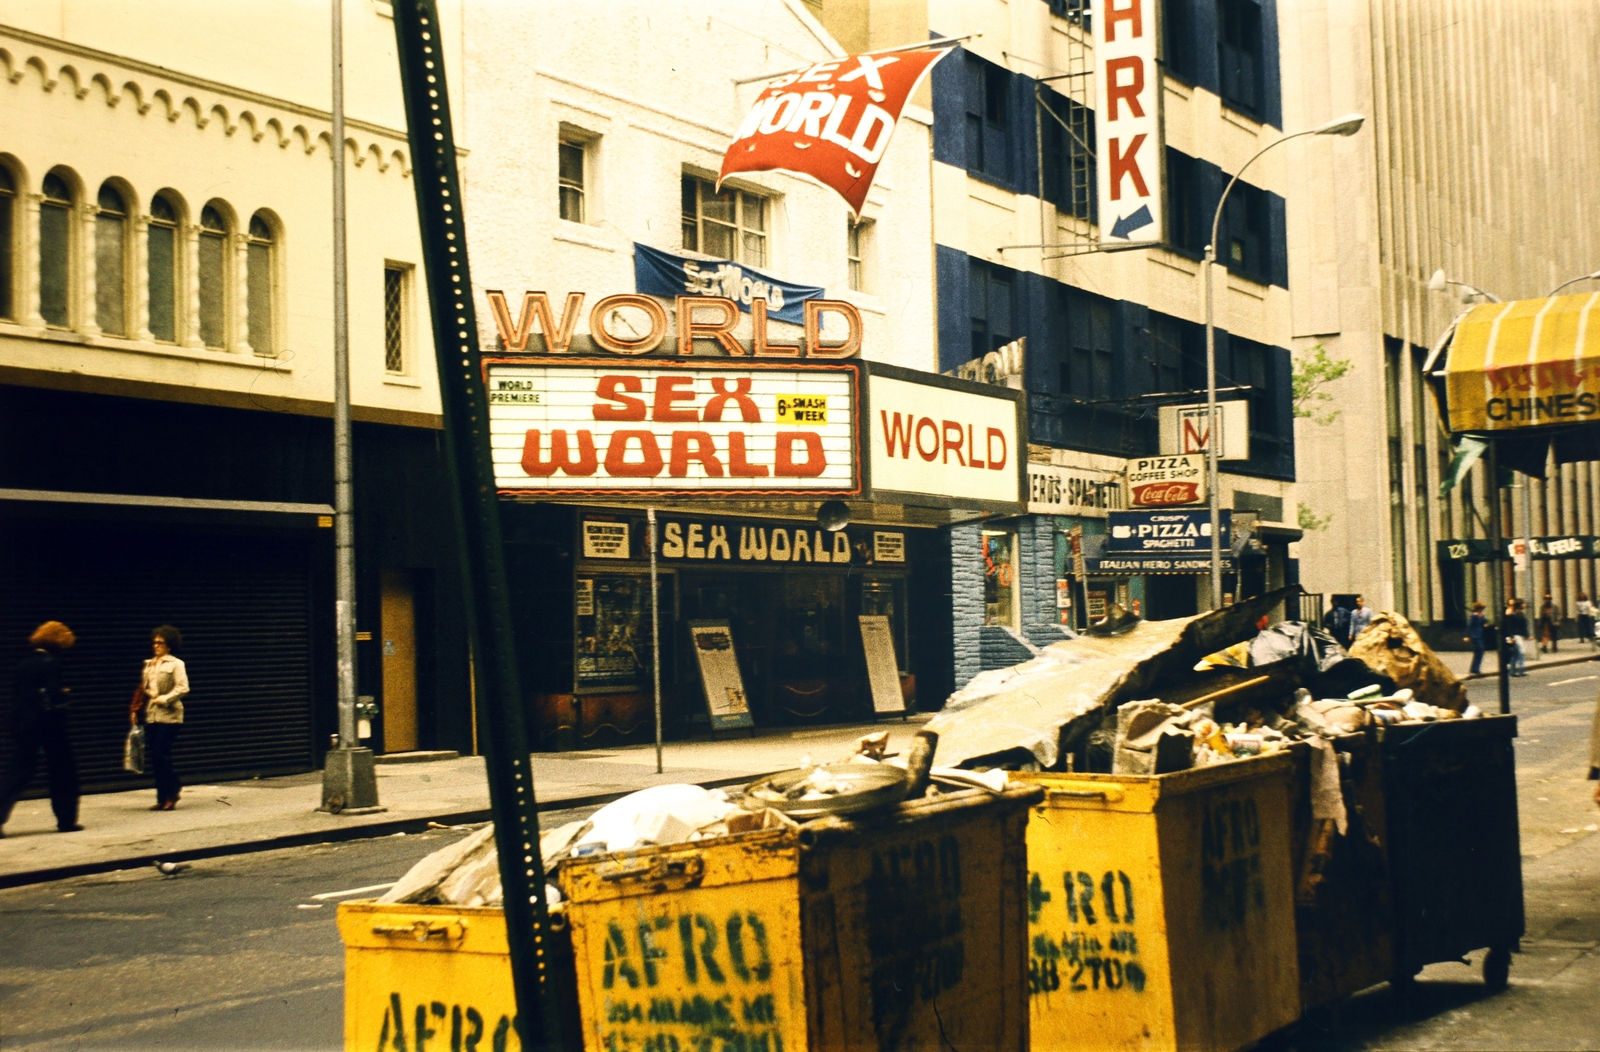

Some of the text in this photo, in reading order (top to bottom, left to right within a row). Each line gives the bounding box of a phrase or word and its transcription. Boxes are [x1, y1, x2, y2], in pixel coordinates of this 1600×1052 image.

[769, 55, 901, 90] SEX
[732, 91, 897, 164] WORLD
[487, 291, 863, 359] WORLD
[498, 381, 533, 391] WORLD
[490, 393, 540, 403] PREMIERE
[592, 375, 761, 422] SEX
[793, 398, 826, 409] SMASH
[1487, 392, 1600, 421] CHINES
[794, 410, 826, 421] WEEK
[880, 409, 1007, 470] WORLD
[521, 429, 827, 477] WORLD
[1138, 457, 1190, 471] PIZZA
[1129, 468, 1199, 482] COFFEE SHOP
[1027, 473, 1061, 504] EROS
[1150, 515, 1190, 523] CRISPY
[1138, 523, 1200, 538] PIZZA
[662, 522, 732, 560] SEX
[739, 526, 851, 564] WORLD
[1143, 539, 1195, 549] SPAGHETTI
[1099, 560, 1232, 570] ITALIAN HERO SANDWICES
[603, 912, 772, 989] AFRO
